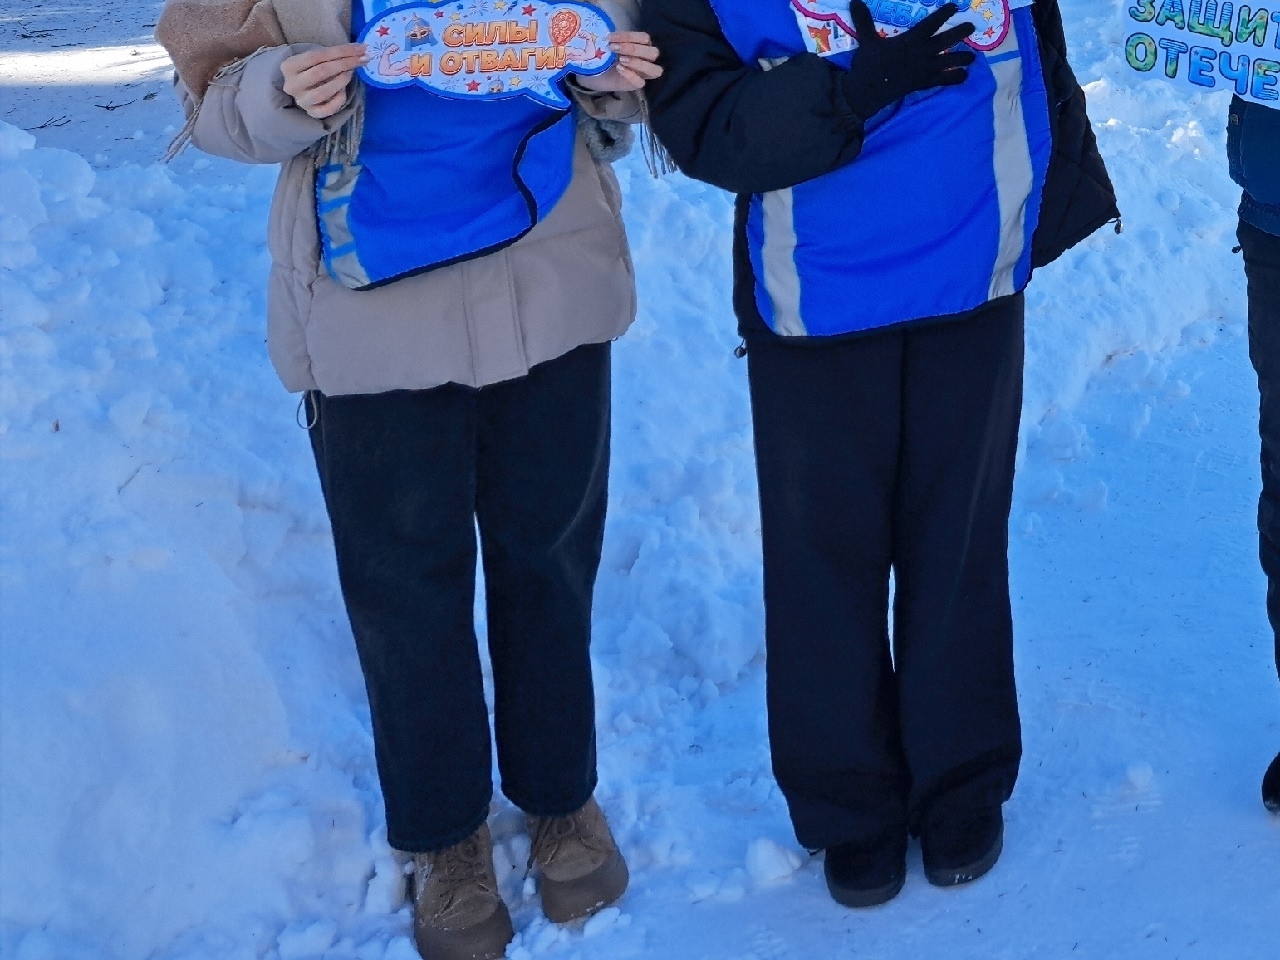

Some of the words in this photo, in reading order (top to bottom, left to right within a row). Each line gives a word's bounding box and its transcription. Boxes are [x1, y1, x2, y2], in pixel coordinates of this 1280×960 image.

[442, 19, 538, 47] СИЛЫ
[410, 51, 434, 77] И
[439, 44, 567, 74] ОТВАГИ!
